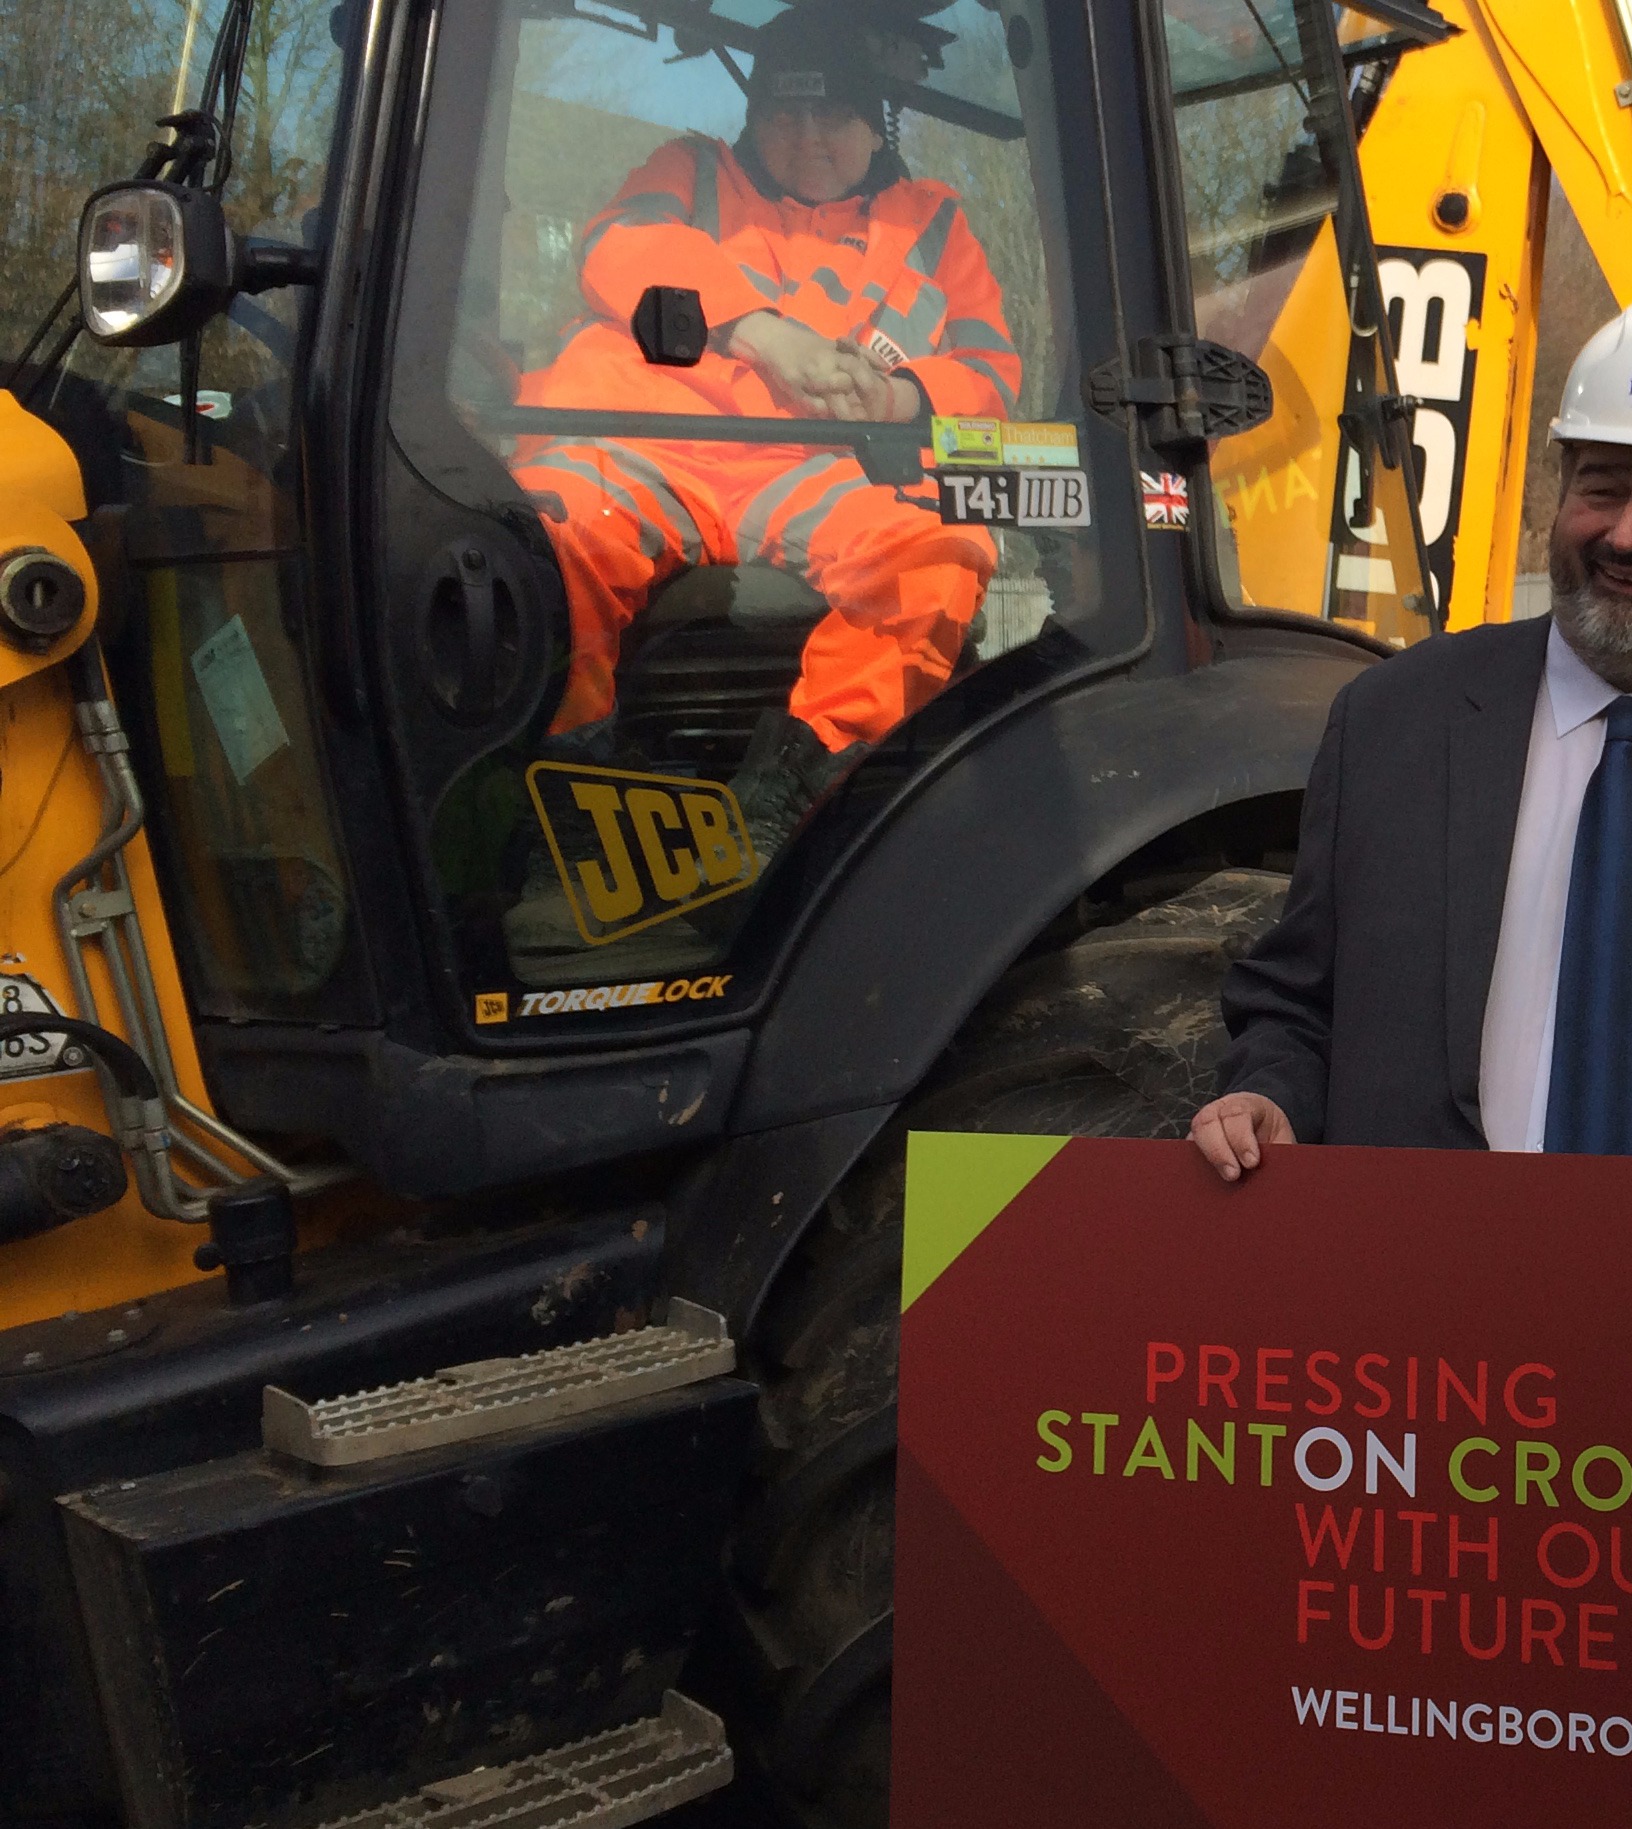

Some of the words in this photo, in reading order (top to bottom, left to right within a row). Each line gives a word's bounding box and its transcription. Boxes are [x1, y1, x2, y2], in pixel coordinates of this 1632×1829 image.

[943, 475, 1015, 520] T4i
[568, 780, 743, 923] JCB
[518, 974, 734, 1017] TORQUELOCK
[1146, 1341, 1559, 1429] PRESSING
[1035, 1409, 1418, 1499] STANTON
[1294, 1503, 1500, 1582] WITH
[1297, 1580, 1620, 1671] FUTURE
